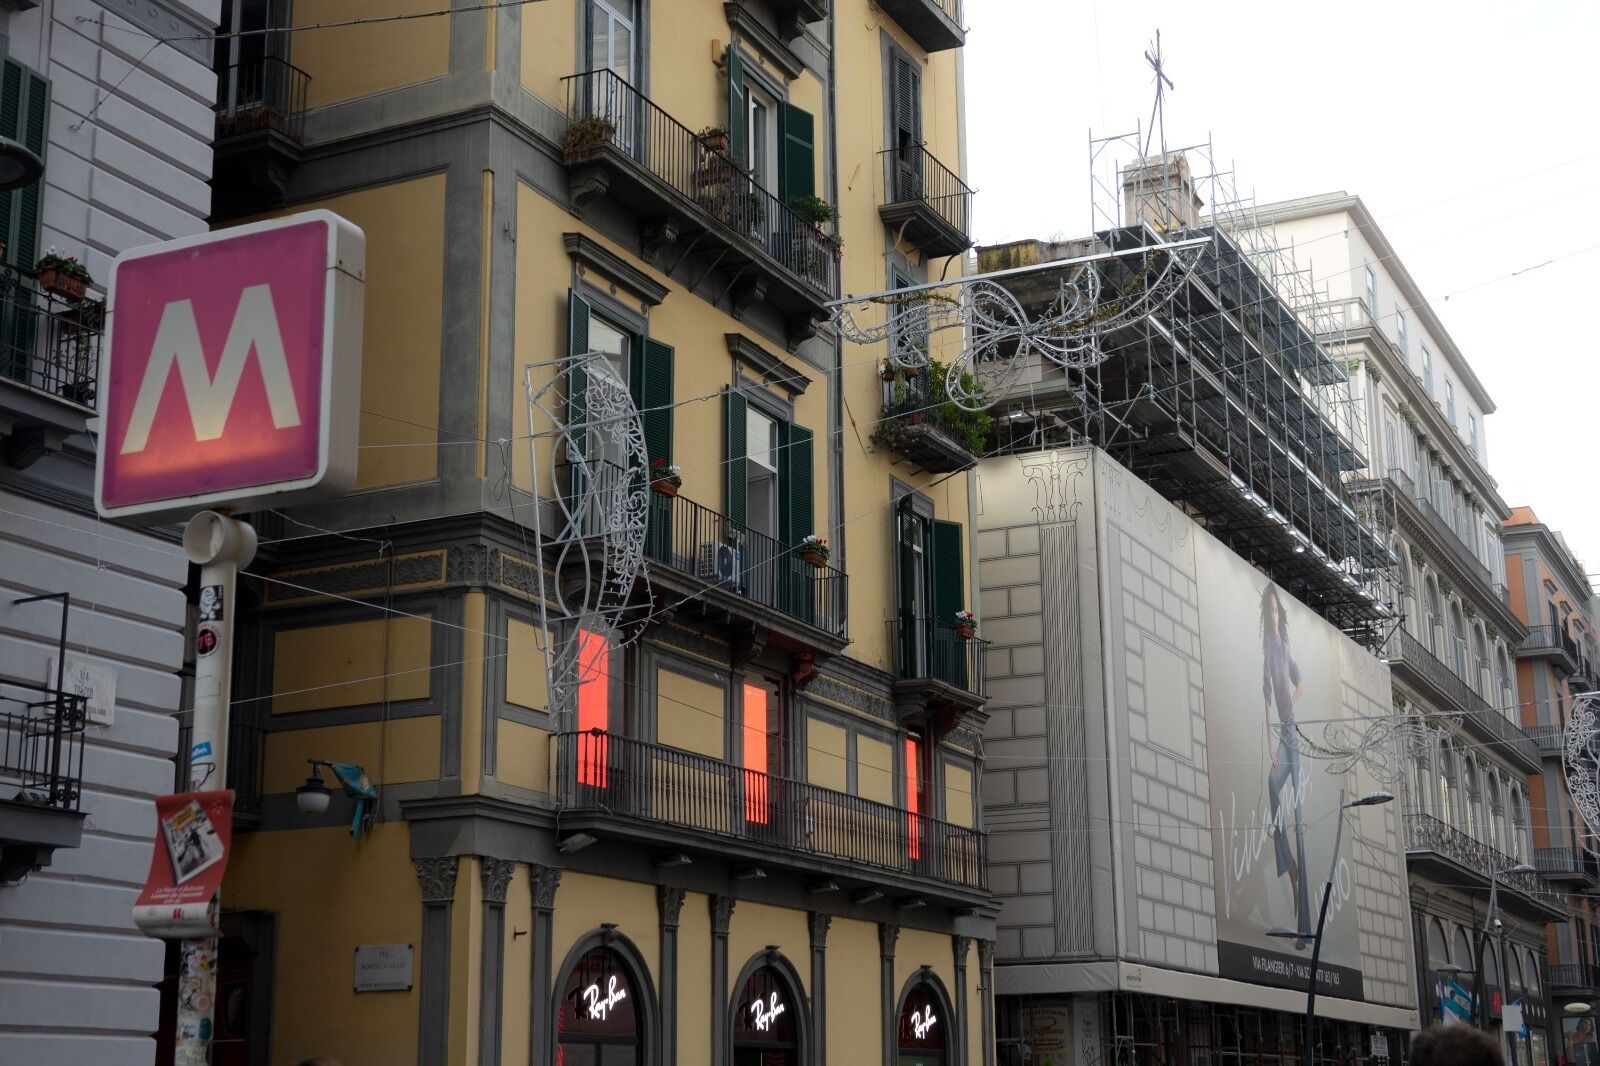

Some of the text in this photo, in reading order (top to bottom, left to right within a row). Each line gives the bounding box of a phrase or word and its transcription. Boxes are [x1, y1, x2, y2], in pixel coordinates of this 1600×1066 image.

[120, 283, 301, 455] M
[1252, 955, 1262, 970] VIA
[1296, 964, 1304, 978] VIA
[583, 975, 626, 1021] Ray-Ban
[750, 991, 785, 1032] Ray-Ban
[910, 1004, 937, 1040] Ray-Ban
